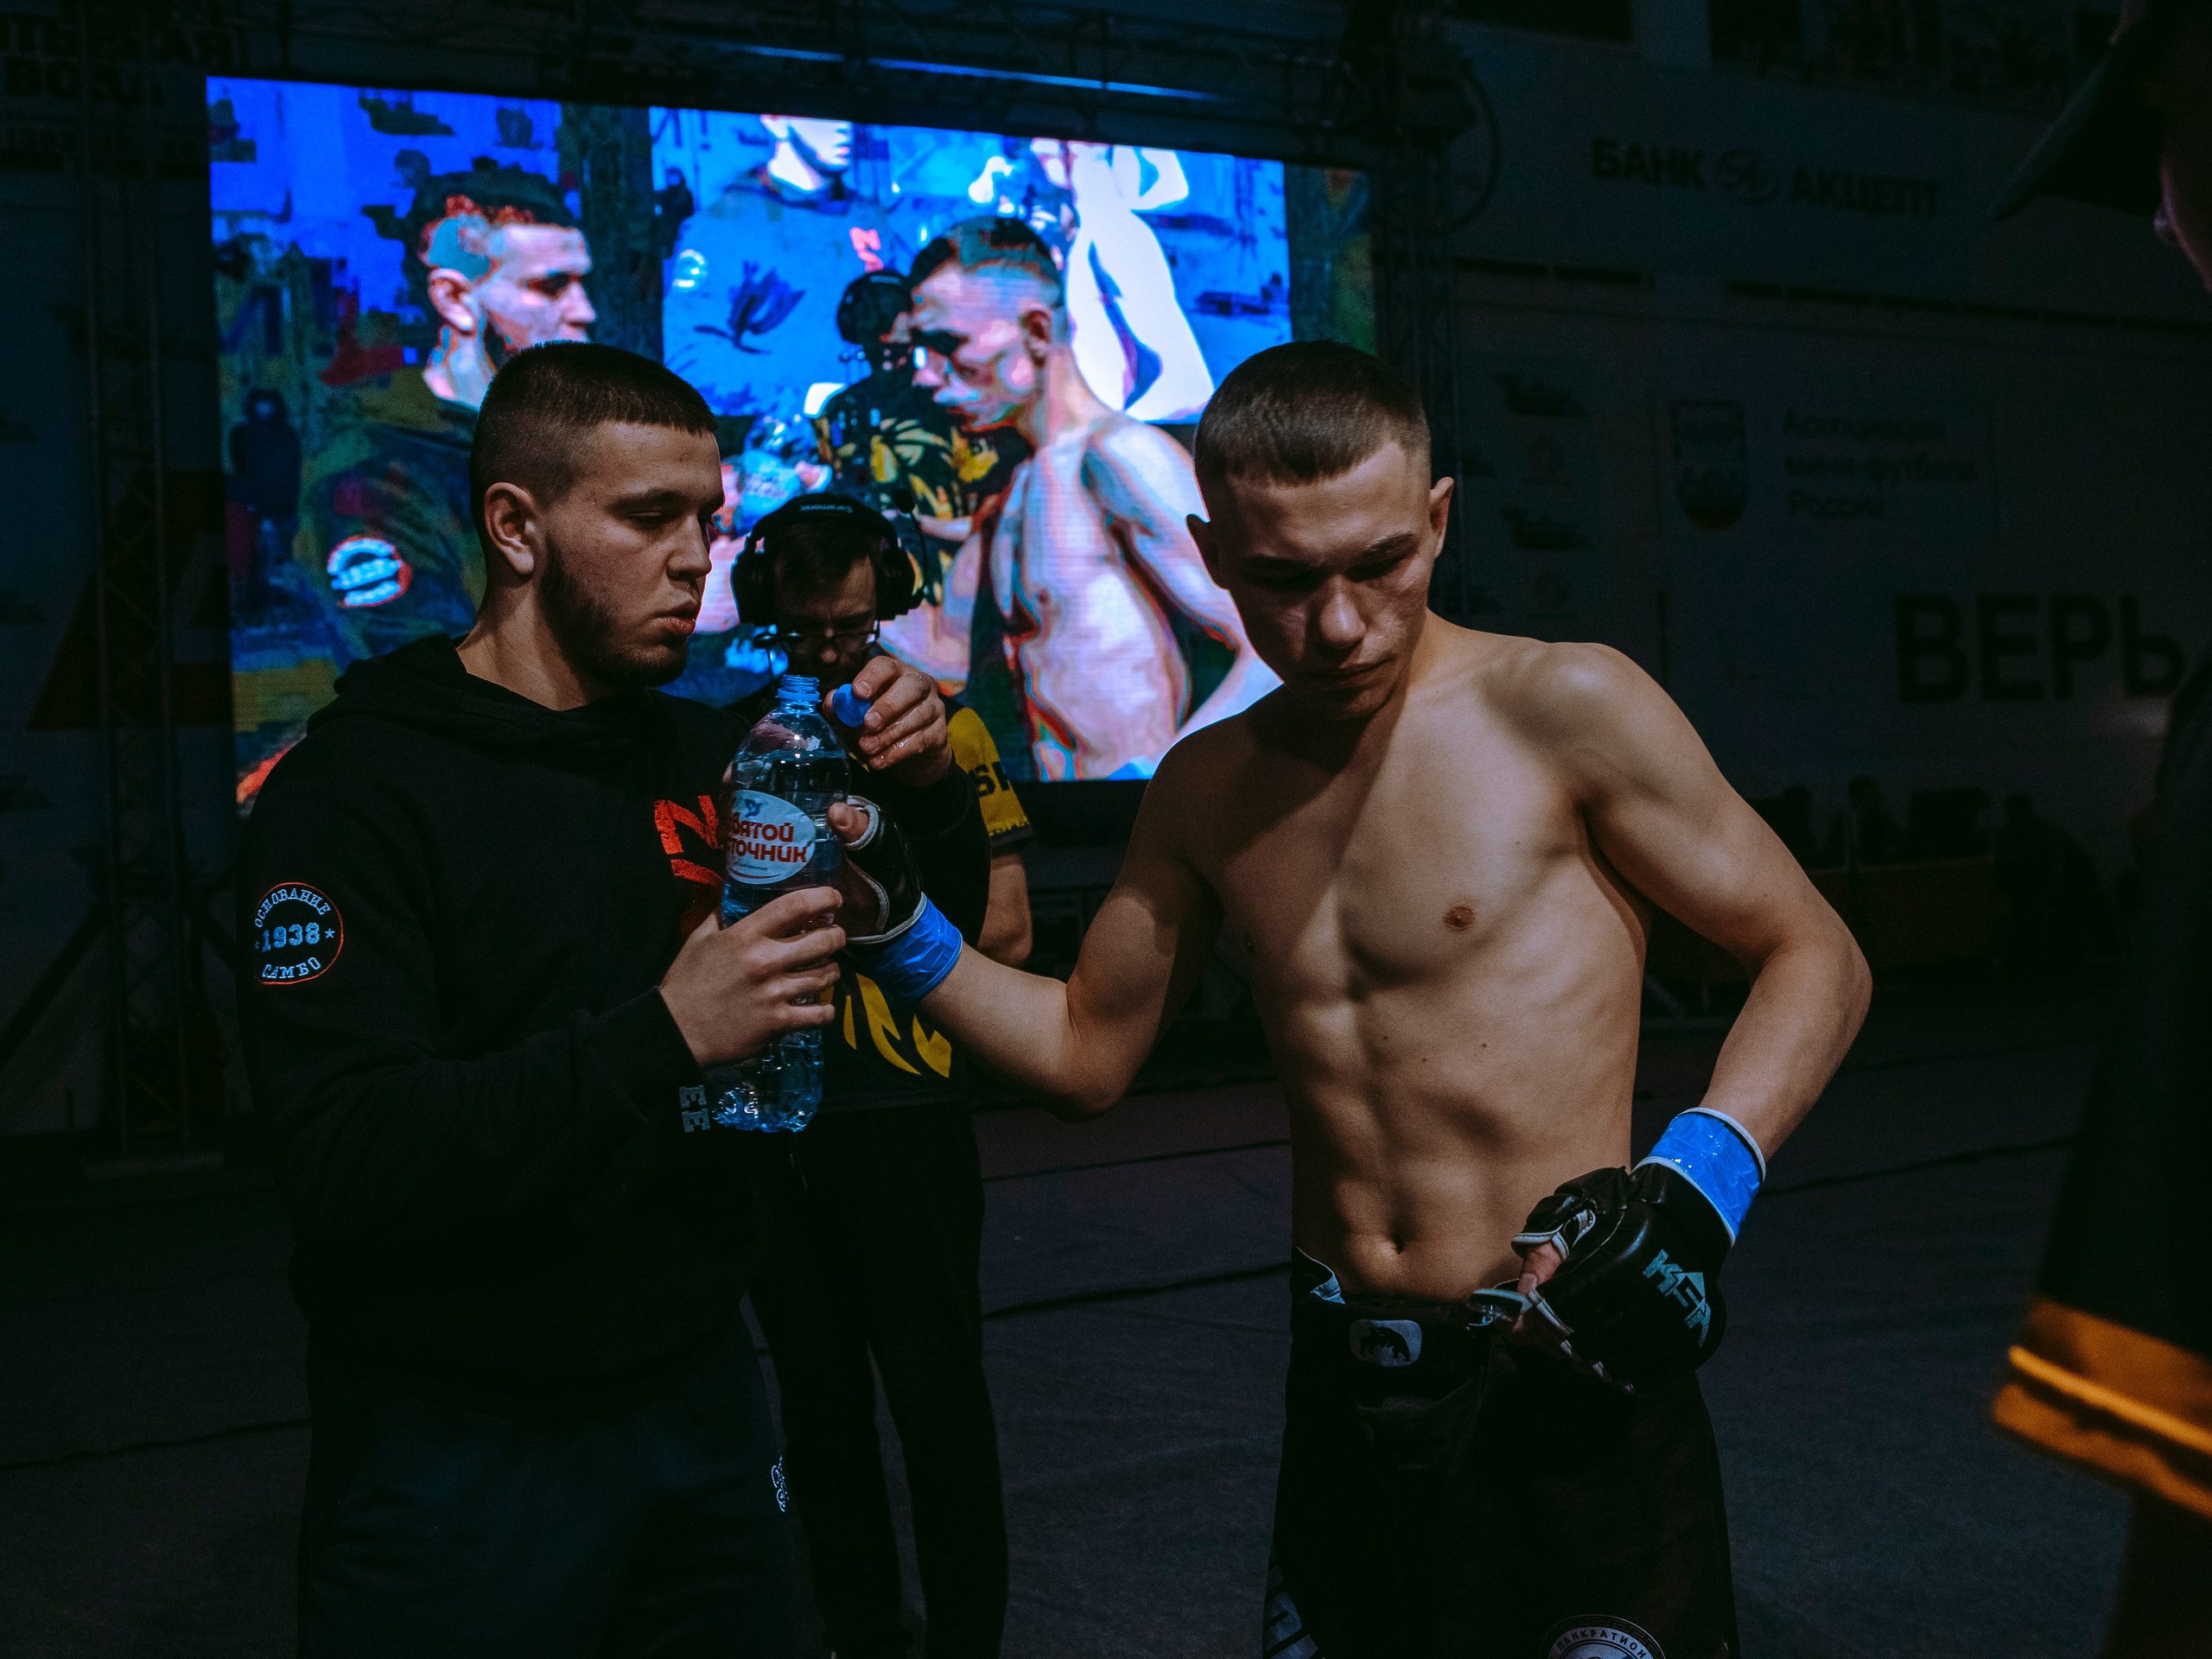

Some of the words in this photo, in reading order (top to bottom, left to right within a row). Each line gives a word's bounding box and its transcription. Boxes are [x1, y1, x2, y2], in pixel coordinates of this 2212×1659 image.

[1592, 138, 1705, 190] БАНК
[1791, 168, 1944, 219] АКЦЕПТ
[254, 887, 331, 928] ОСНОВАНИЕ
[262, 922, 321, 953] 1938
[262, 957, 321, 979] САМБО
[1556, 1629, 1647, 1659] ПАНКРАТИОН
